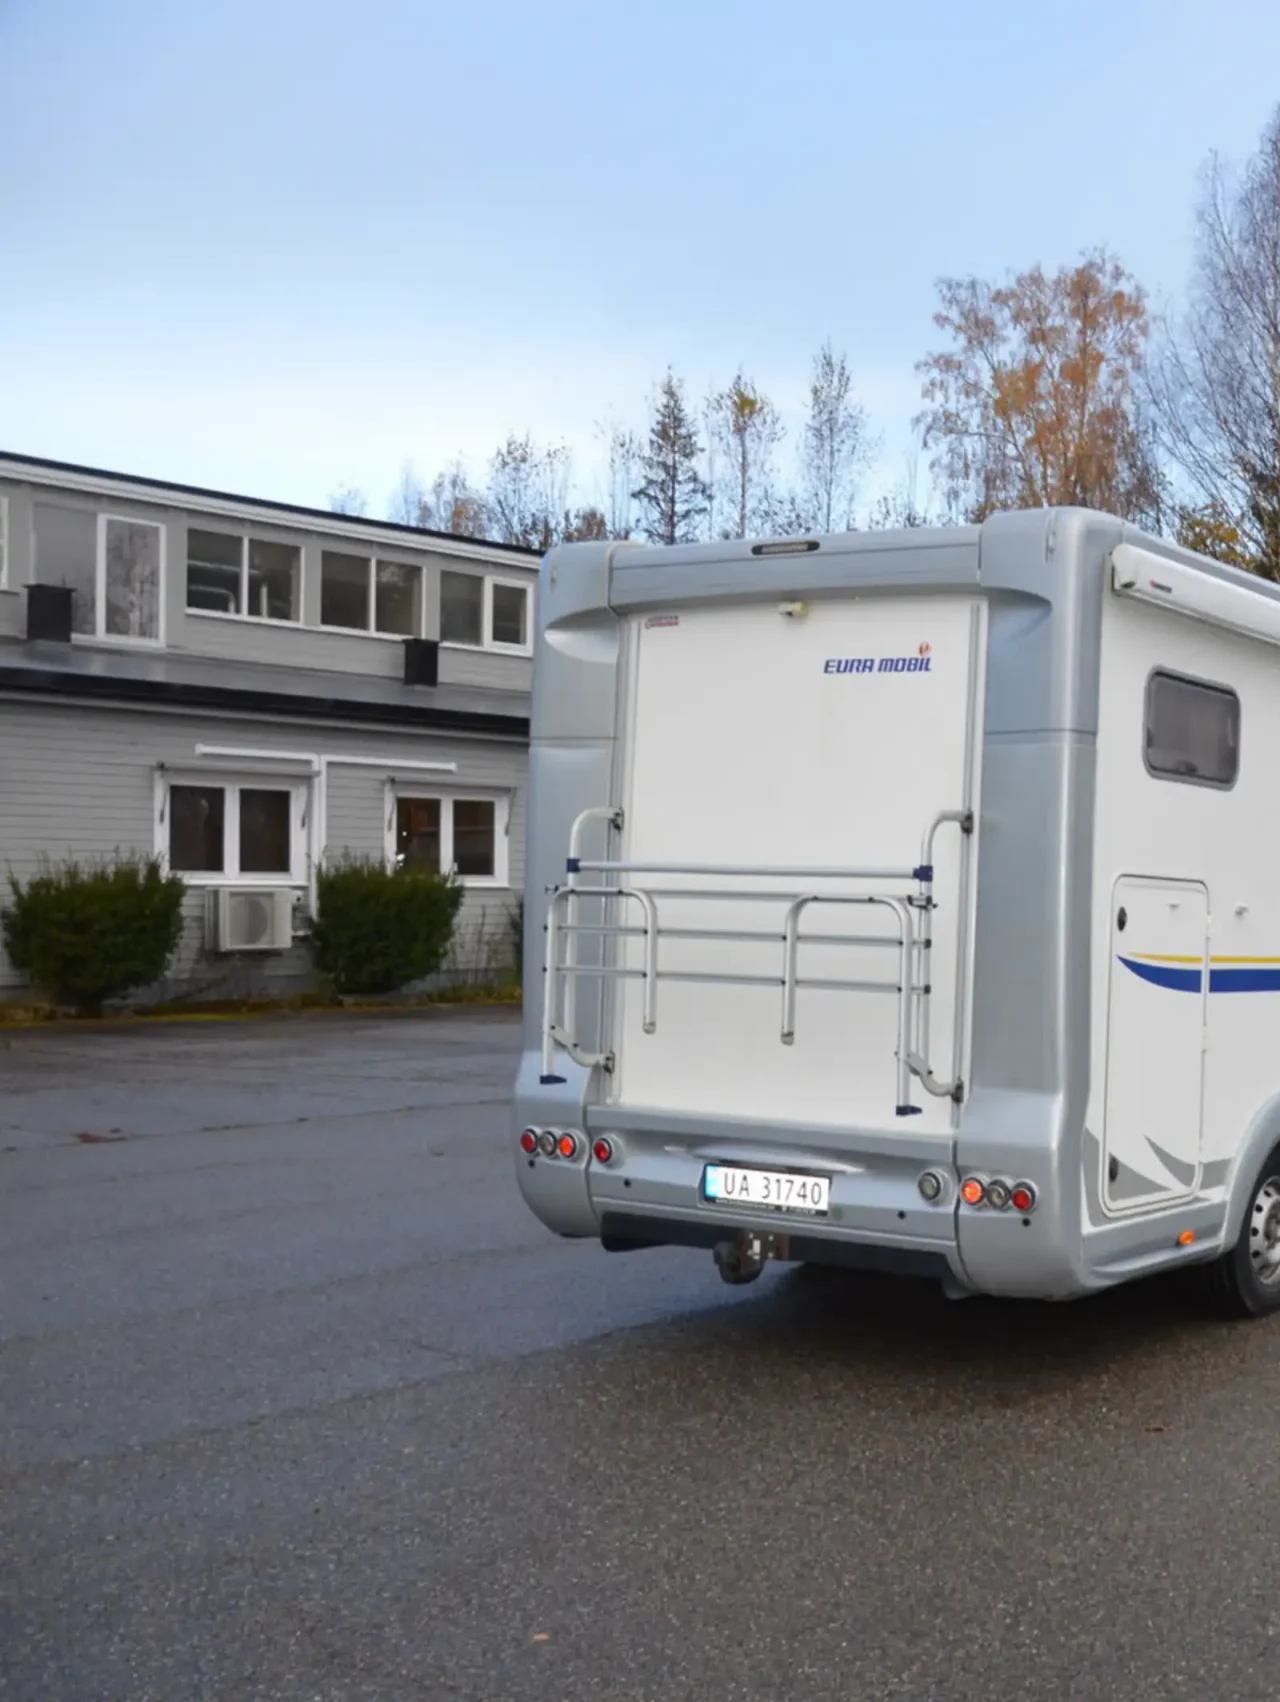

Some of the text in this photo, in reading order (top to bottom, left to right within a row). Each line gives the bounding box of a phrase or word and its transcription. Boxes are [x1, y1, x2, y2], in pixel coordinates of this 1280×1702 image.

[823, 656, 932, 674] EURA MOBIL
[724, 1172, 750, 1197] UA
[761, 1176, 822, 1206] 31740
